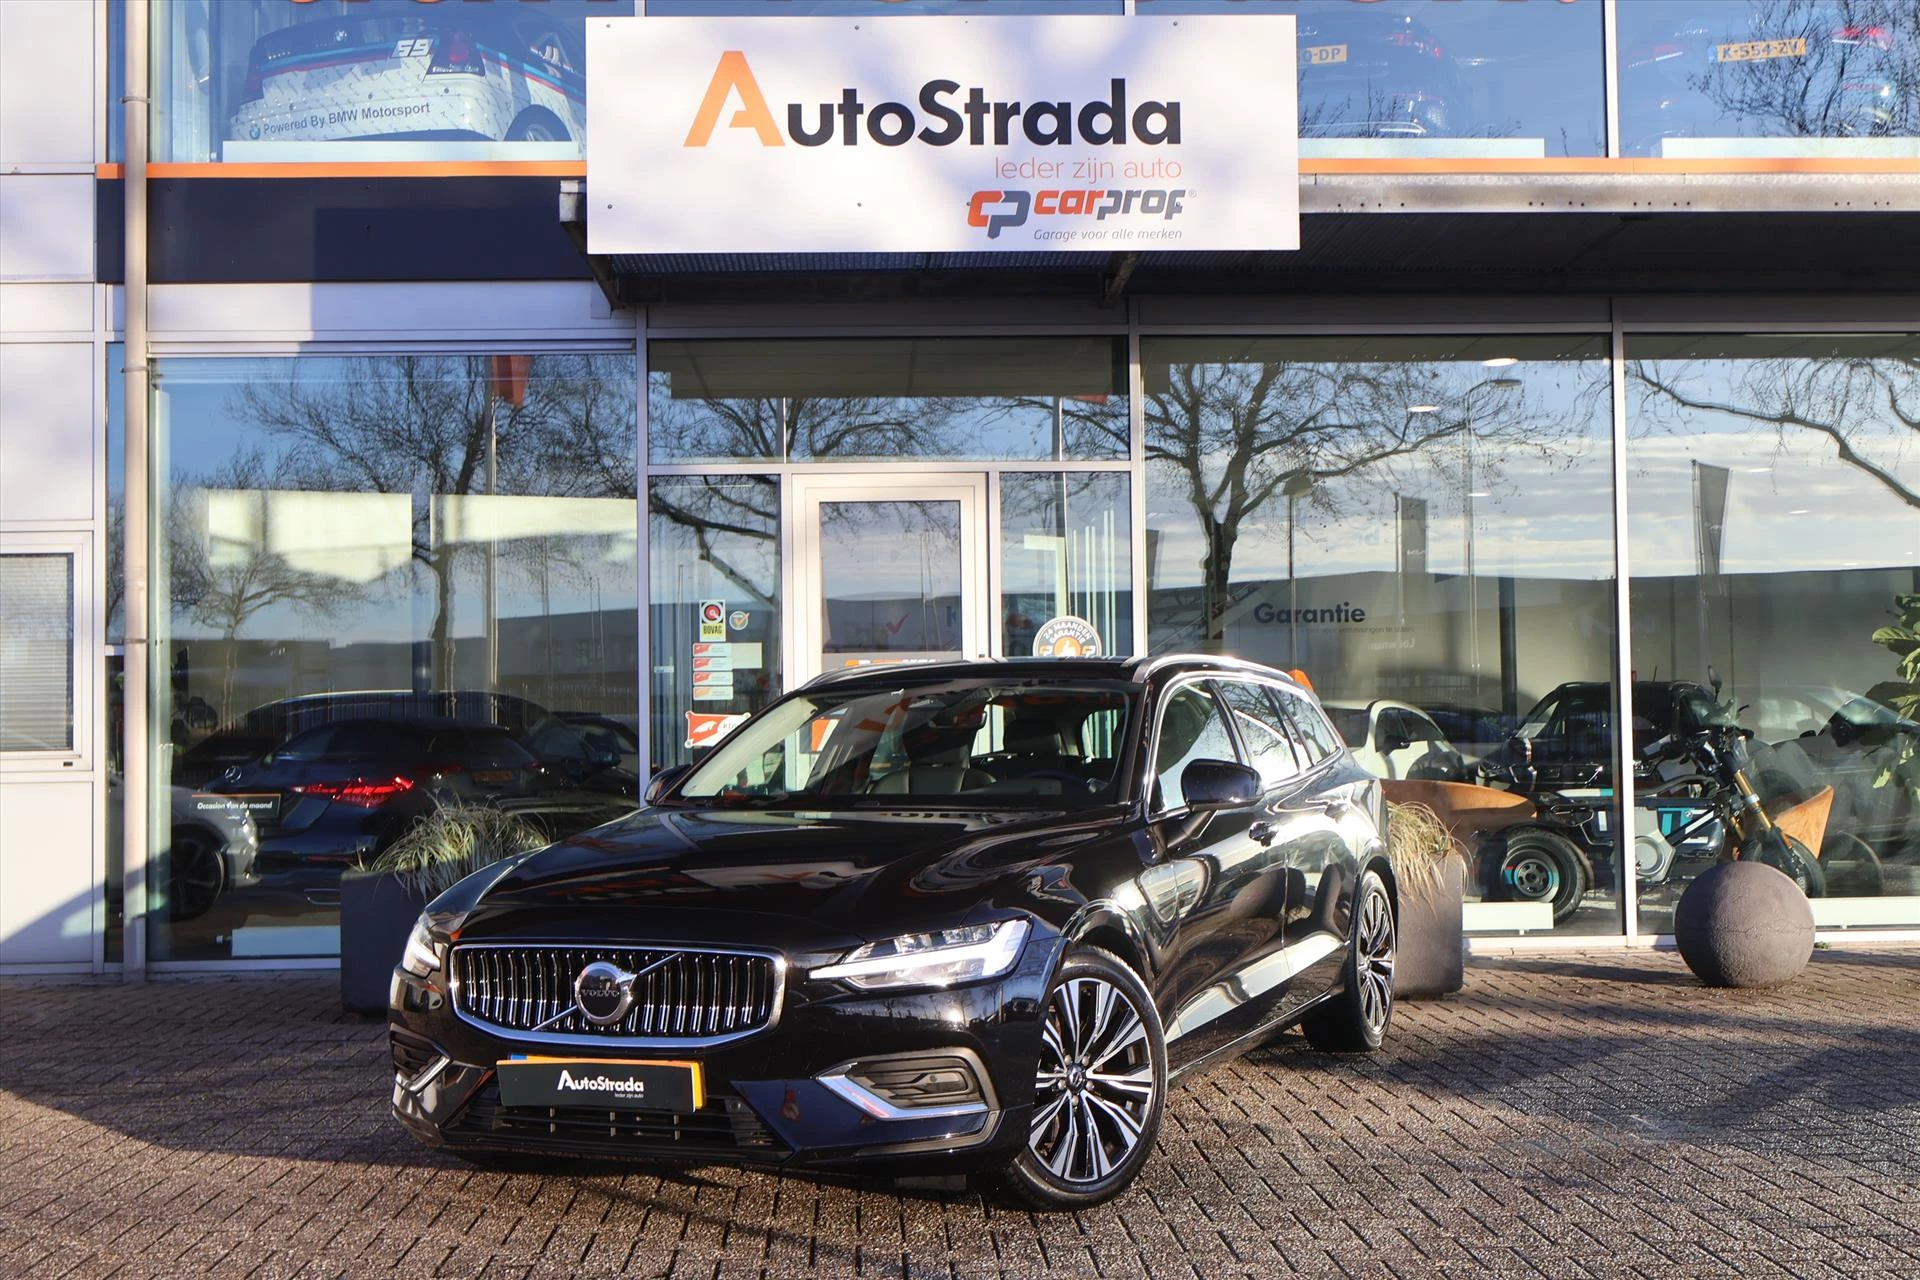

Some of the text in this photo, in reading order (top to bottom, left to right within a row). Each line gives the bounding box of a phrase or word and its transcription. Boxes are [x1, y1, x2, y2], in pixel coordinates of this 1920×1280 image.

[683, 50, 1182, 147] AutoStrada
[263, 102, 431, 135] Powered By BMW Motorsport
[995, 157, 1182, 184] Ieder zijn auto
[1033, 189, 1186, 220] carprof
[1034, 228, 1183, 241] Garage voor alle merken
[1254, 602, 1366, 624] Garantie
[703, 625, 723, 635] BOVAG
[1049, 629, 1087, 645] GARANTIE
[1053, 622, 1092, 640] MAANDEN
[197, 801, 225, 810] Occasion
[240, 801, 248, 810] de
[249, 801, 273, 810] maand
[581, 989, 620, 998] VOLVO
[557, 1069, 645, 1092] AutoStrada
